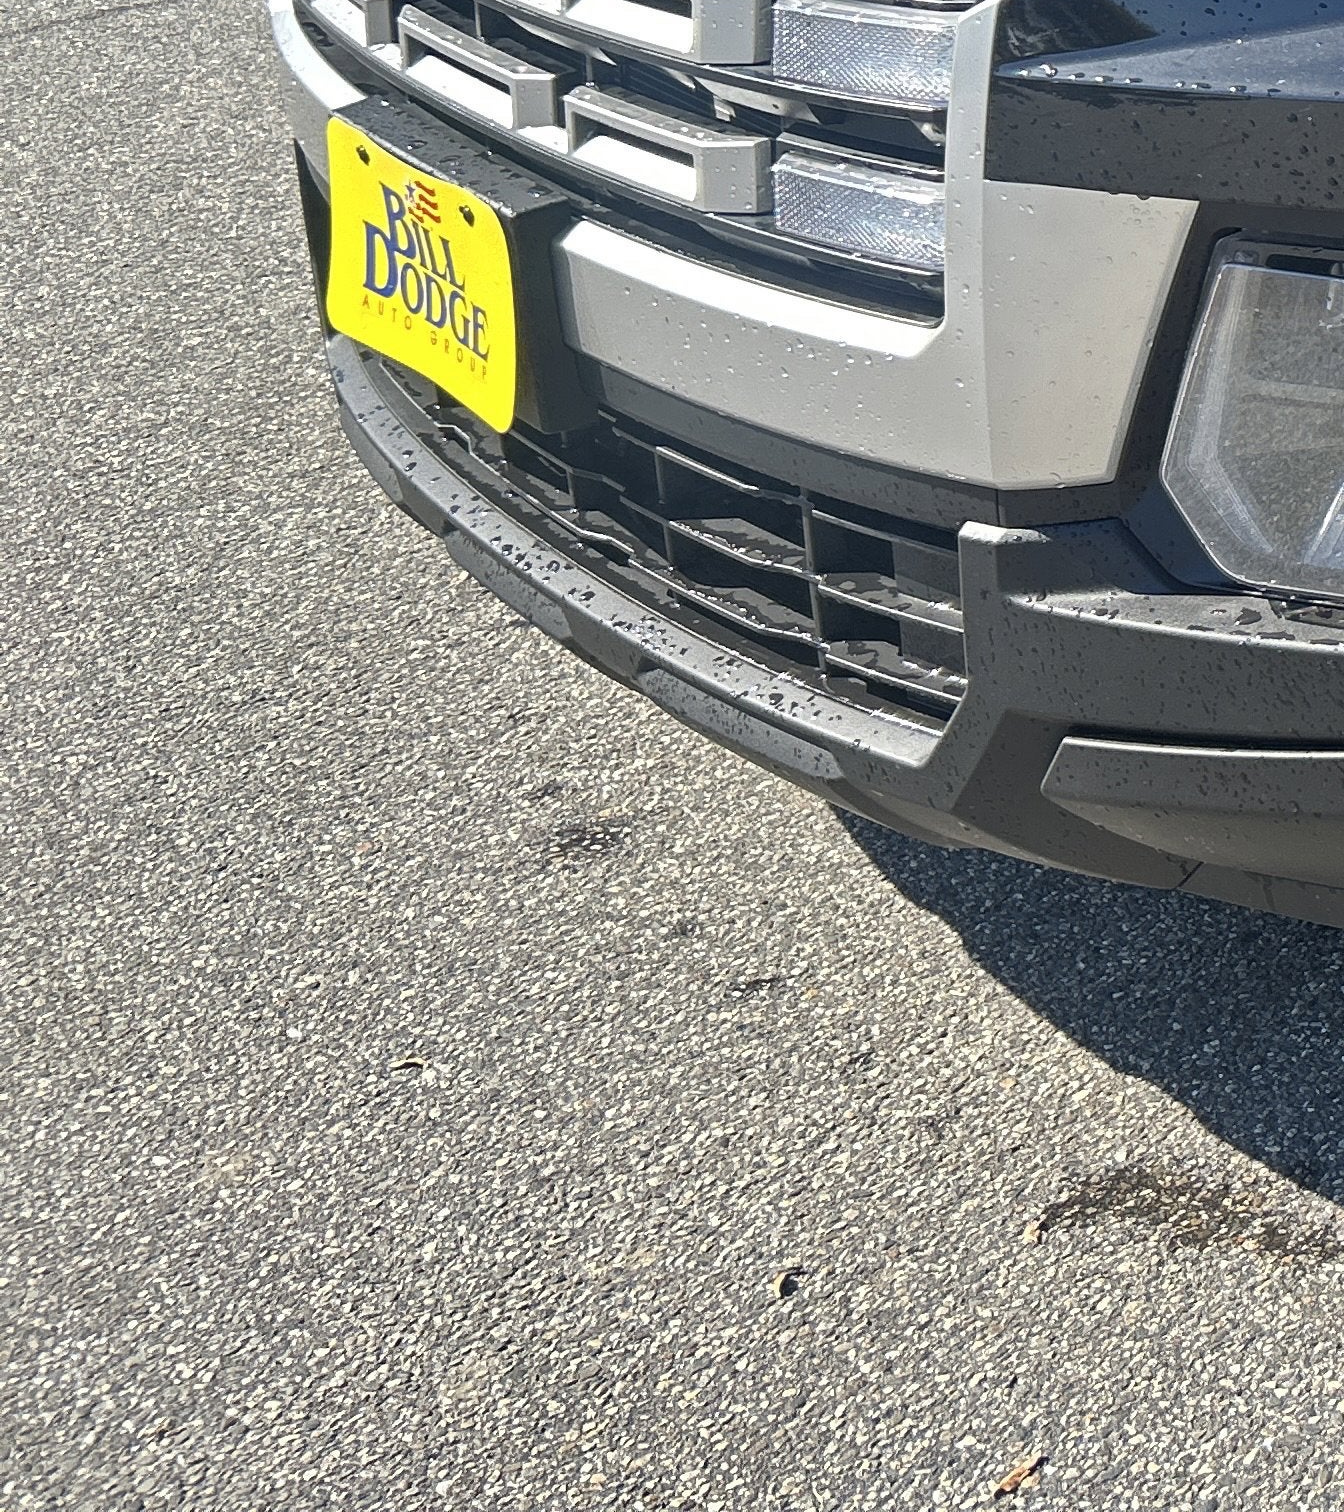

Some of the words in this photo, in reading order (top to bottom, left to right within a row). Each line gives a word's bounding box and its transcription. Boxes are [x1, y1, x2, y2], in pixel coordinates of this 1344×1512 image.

[362, 219, 491, 362] DODGE
[379, 181, 466, 294] BILL
[362, 294, 412, 331] AUTO
[430, 330, 488, 381] GROUP
